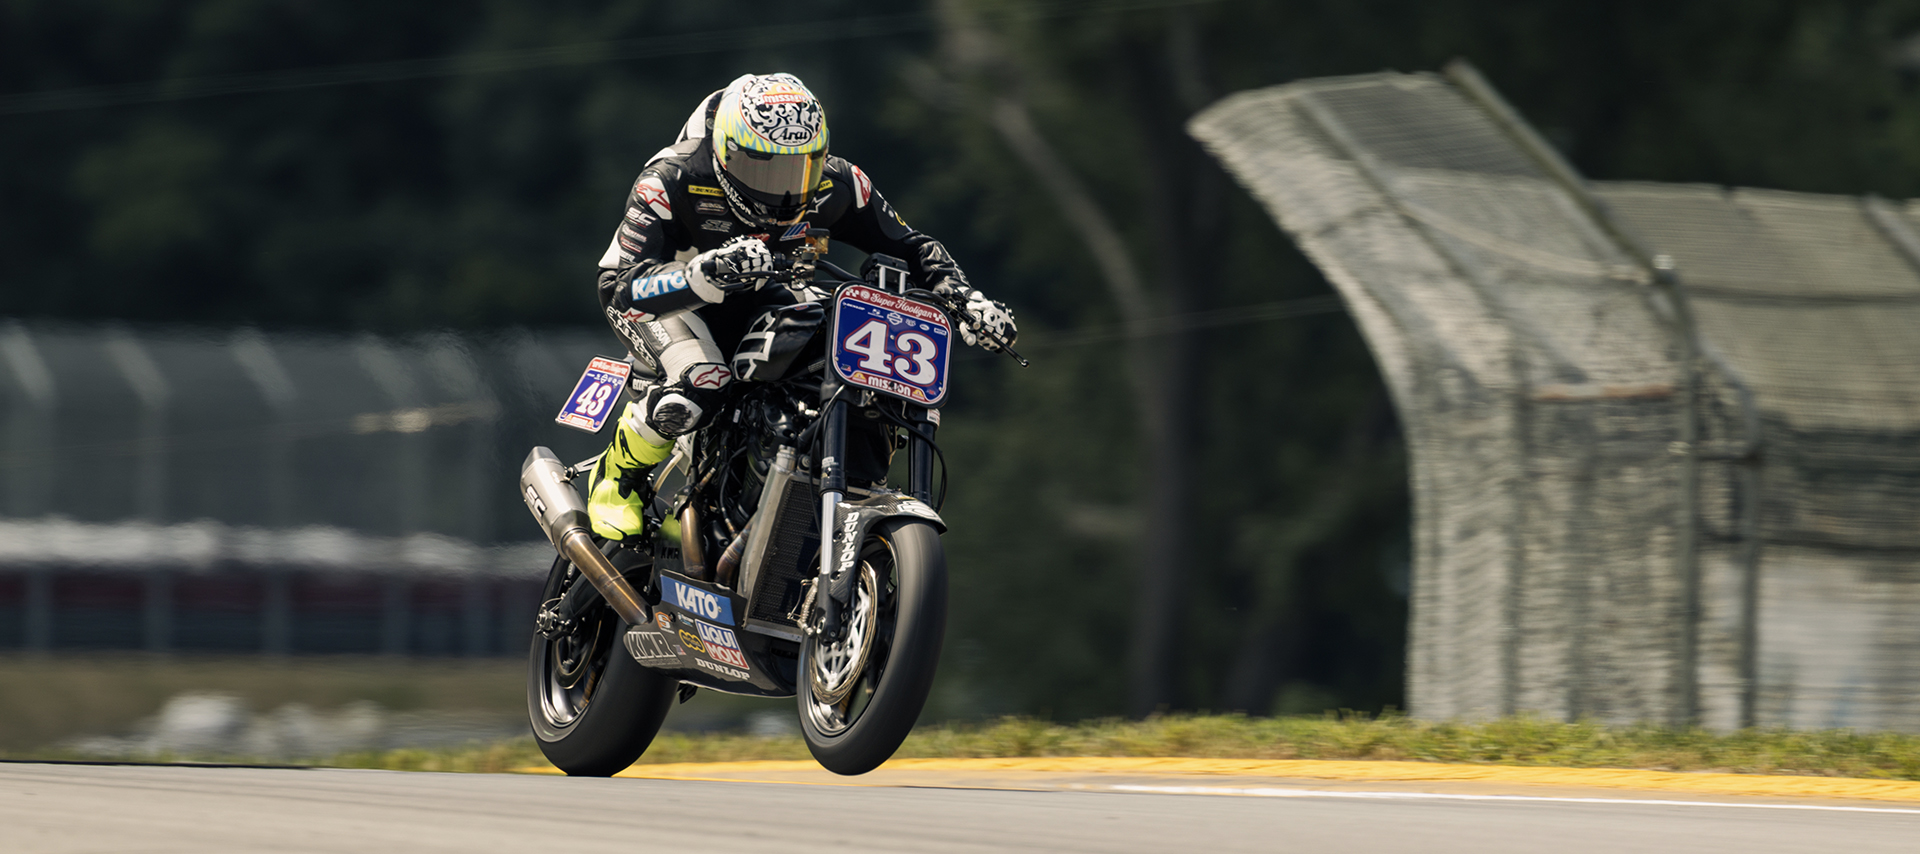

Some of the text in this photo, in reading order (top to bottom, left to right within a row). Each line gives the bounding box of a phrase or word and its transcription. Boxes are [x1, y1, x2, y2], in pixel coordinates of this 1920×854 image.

[773, 128, 807, 141] Arai
[632, 270, 686, 300] KATO
[870, 292, 894, 308] Super
[895, 299, 933, 318] Hooligan
[844, 319, 938, 385] 43
[576, 381, 612, 416] 43
[838, 511, 859, 572] DUNLOP
[675, 582, 718, 619] KATO
[698, 622, 737, 649] LIQUI
[695, 657, 750, 680] DUNLOP
[704, 642, 744, 667] MOLY
